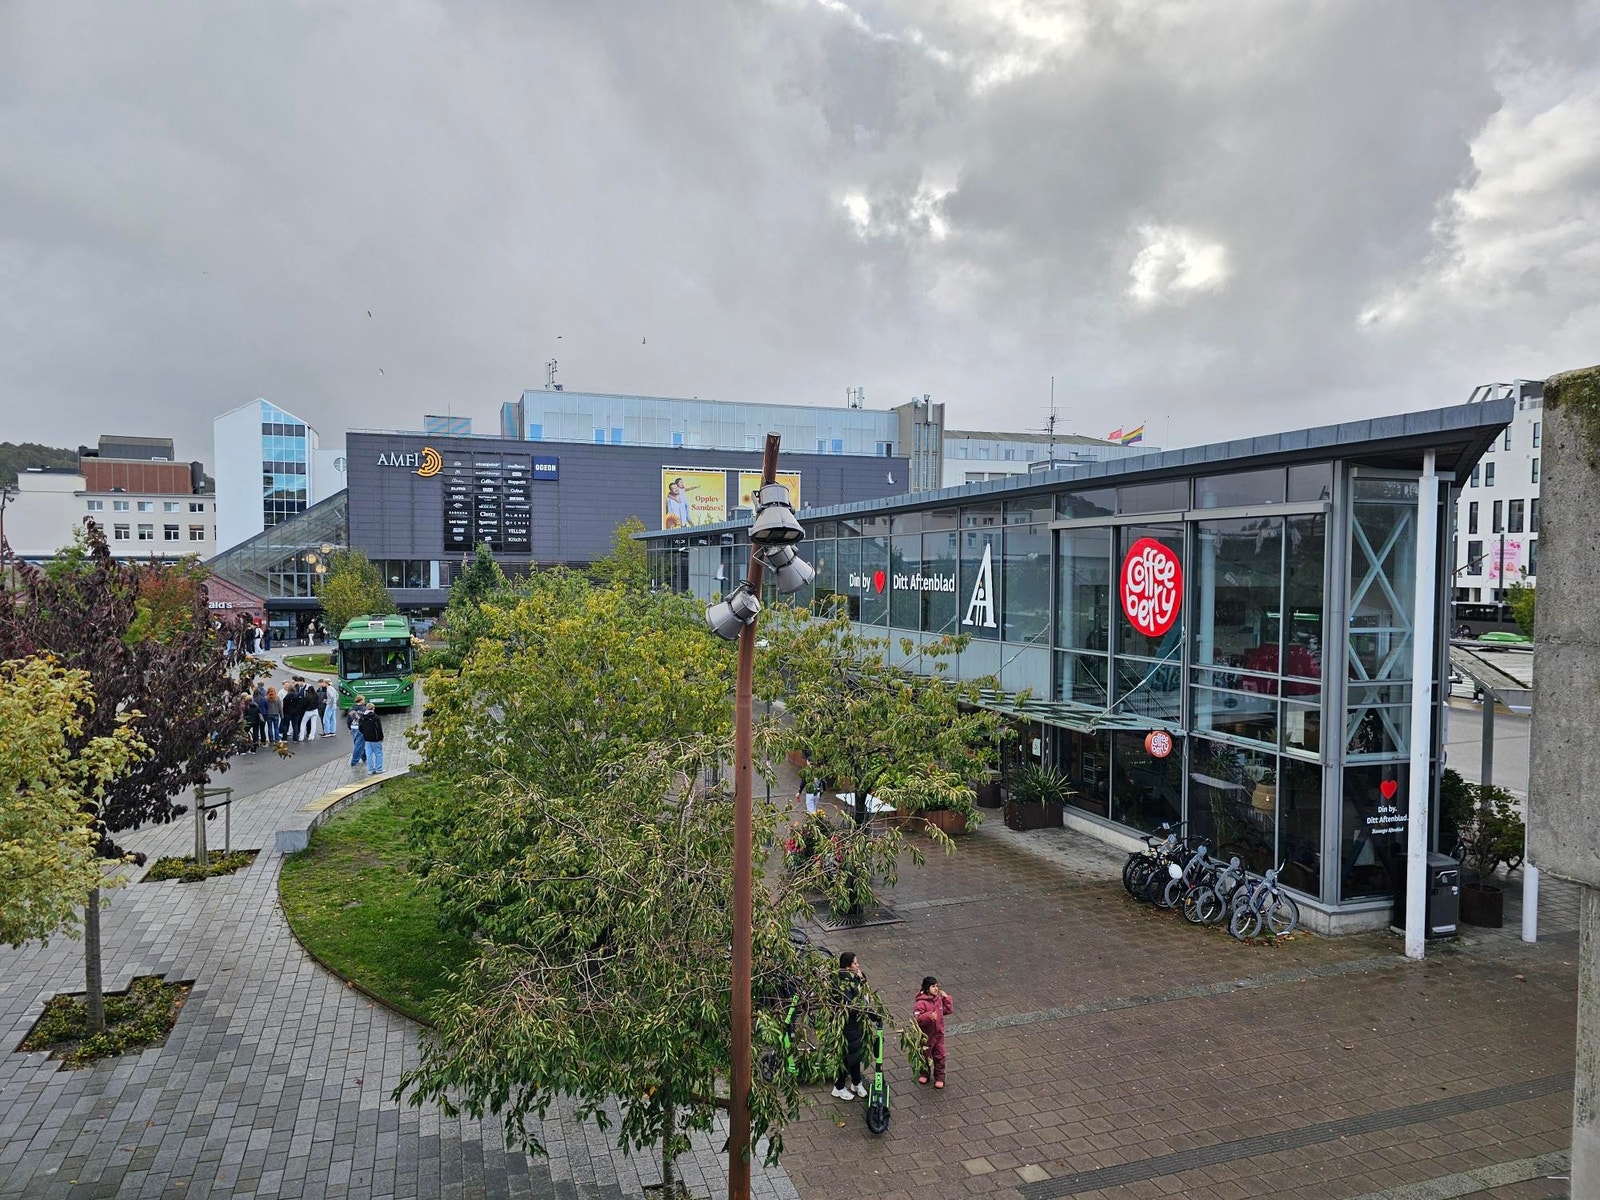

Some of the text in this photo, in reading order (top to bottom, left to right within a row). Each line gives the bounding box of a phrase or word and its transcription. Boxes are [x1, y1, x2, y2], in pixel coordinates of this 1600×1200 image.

[377, 452, 419, 467] AMFI
[695, 495, 719, 503] Opplev
[1127, 547, 1175, 597] Coffee
[849, 572, 955, 592] Din by Ditt Aftenblad
[1126, 583, 1176, 632] berry
[1152, 733, 1168, 747] Coffee
[1151, 744, 1169, 756] berry
[1378, 805, 1388, 813] Din
[1366, 816, 1379, 824] Ditt
